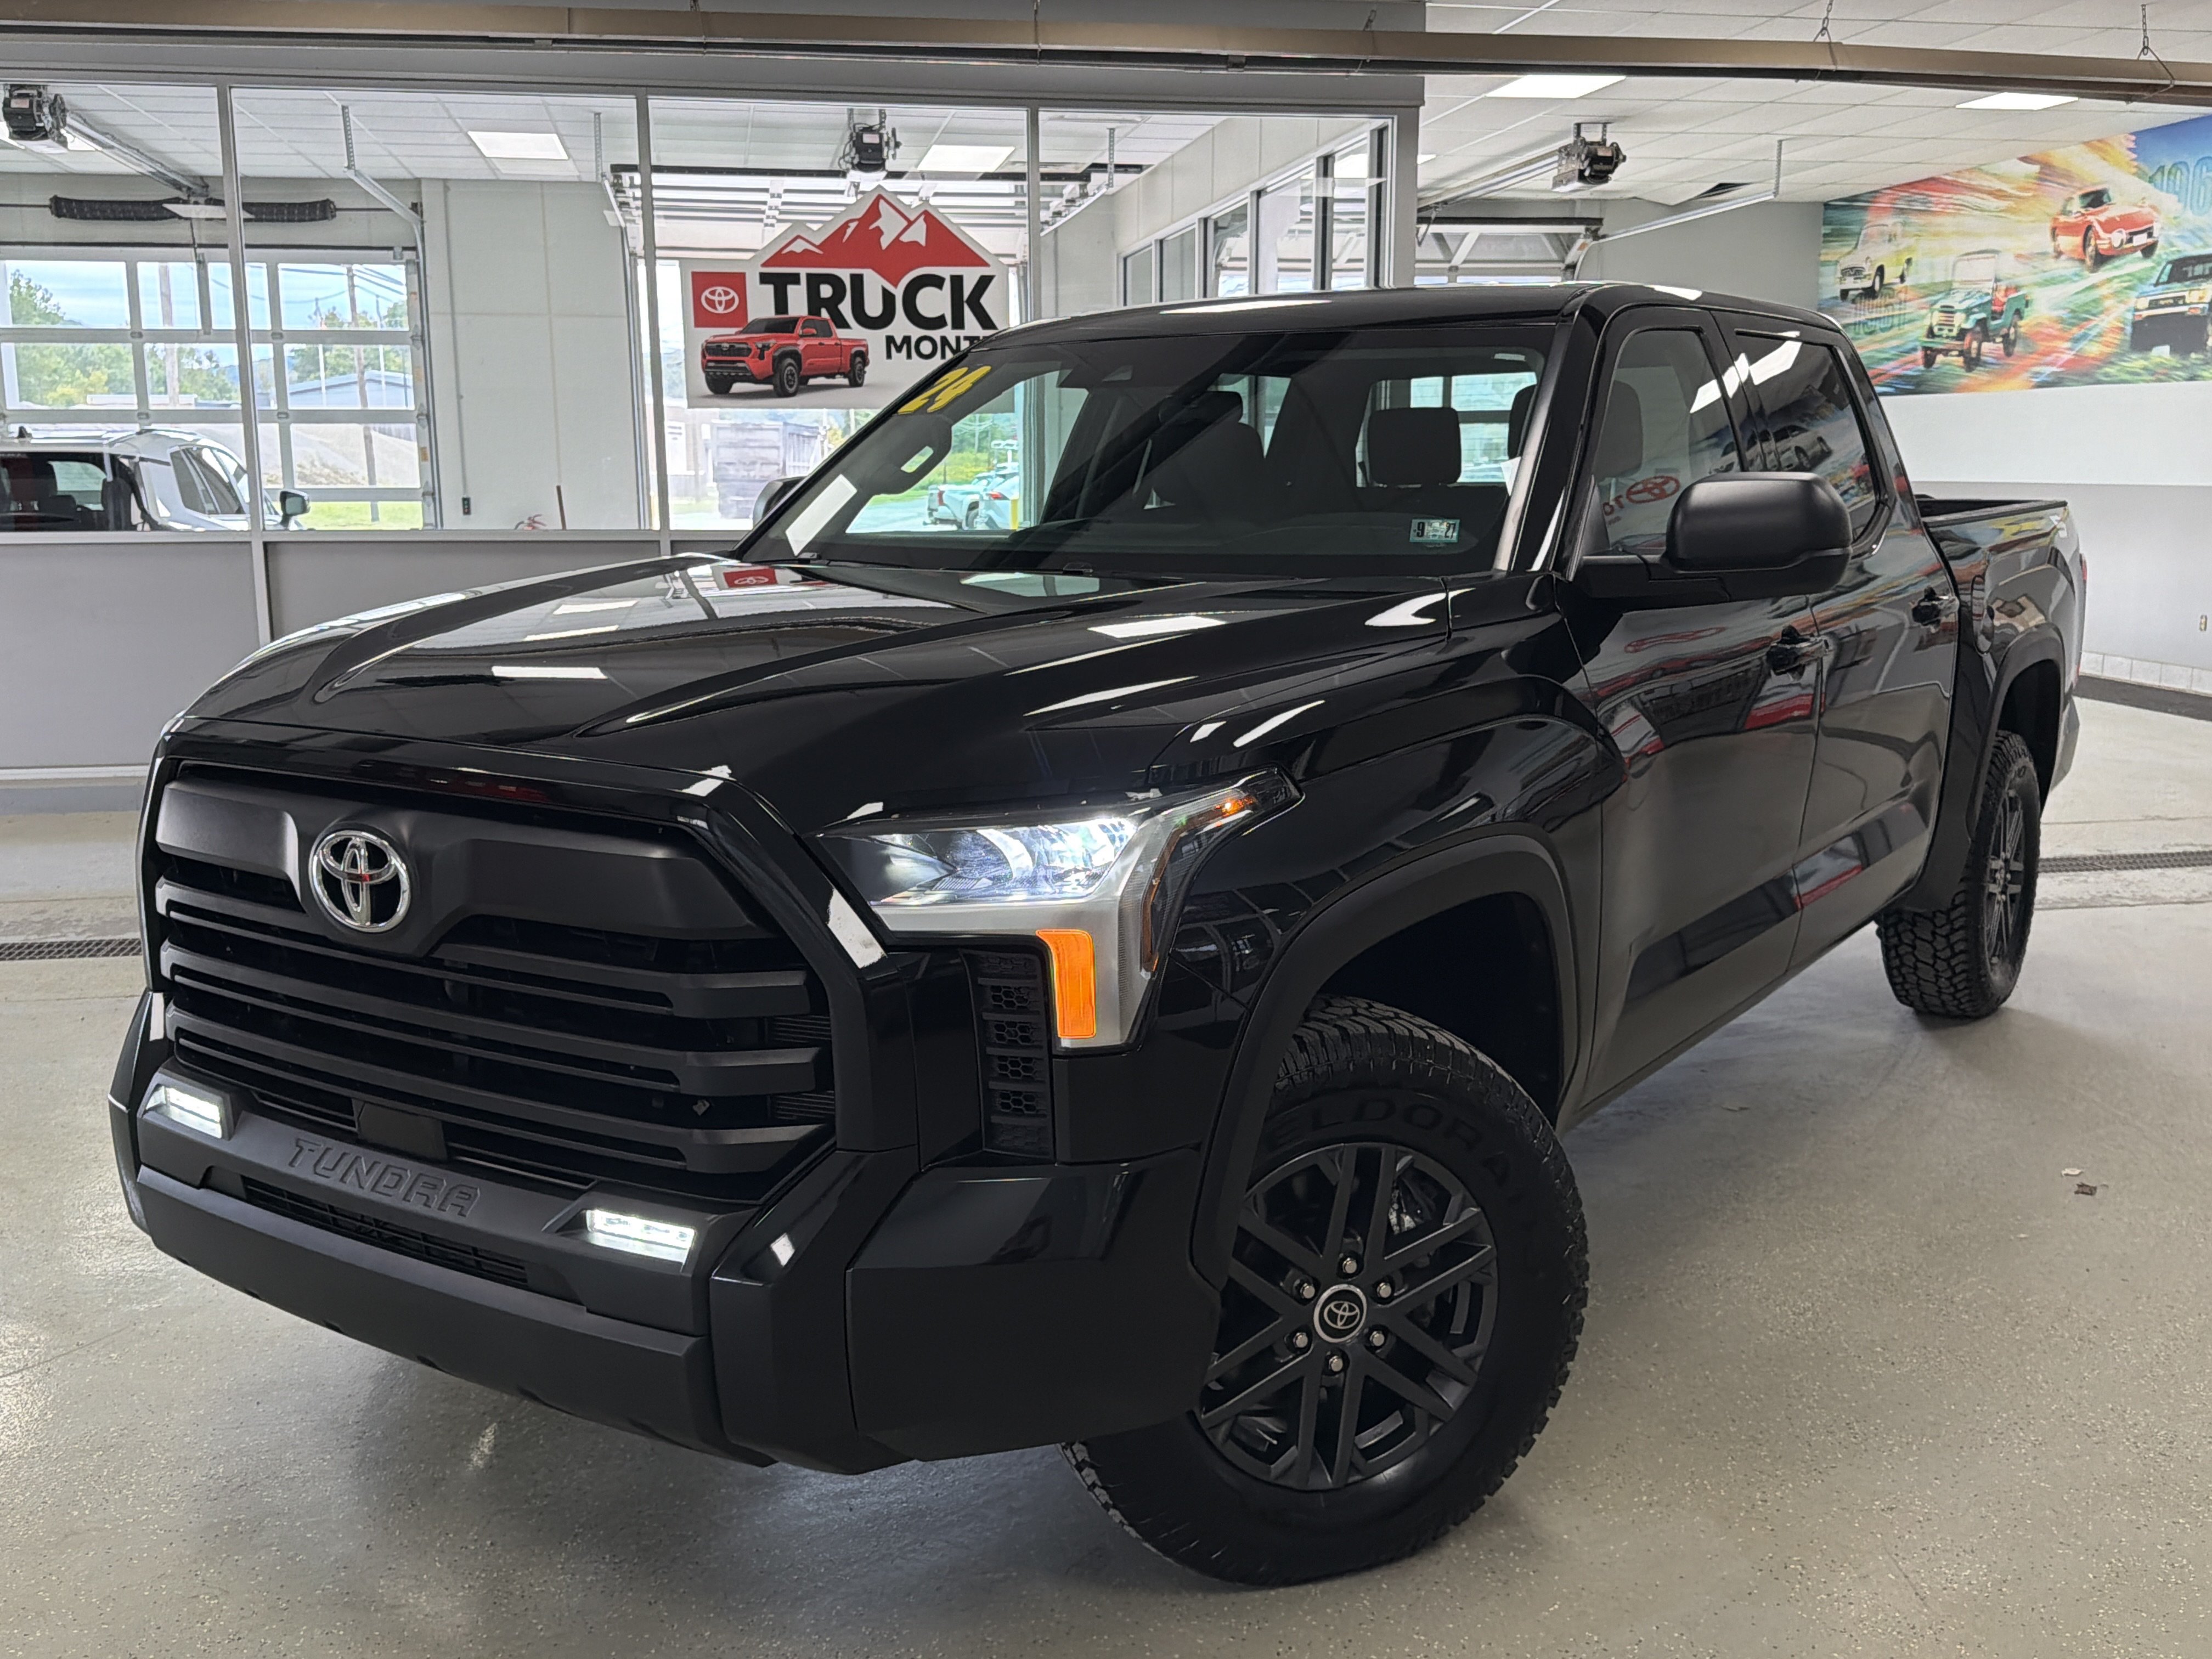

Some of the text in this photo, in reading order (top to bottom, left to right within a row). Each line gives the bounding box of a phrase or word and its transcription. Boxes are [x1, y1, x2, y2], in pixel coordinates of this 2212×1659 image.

[759, 272, 998, 330] TRUCK
[885, 335, 989, 360] MONT
[897, 365, 992, 415] 24
[1416, 521, 1425, 538] 9
[1444, 522, 1456, 539] 27
[288, 1138, 481, 1218] TUNDRA
